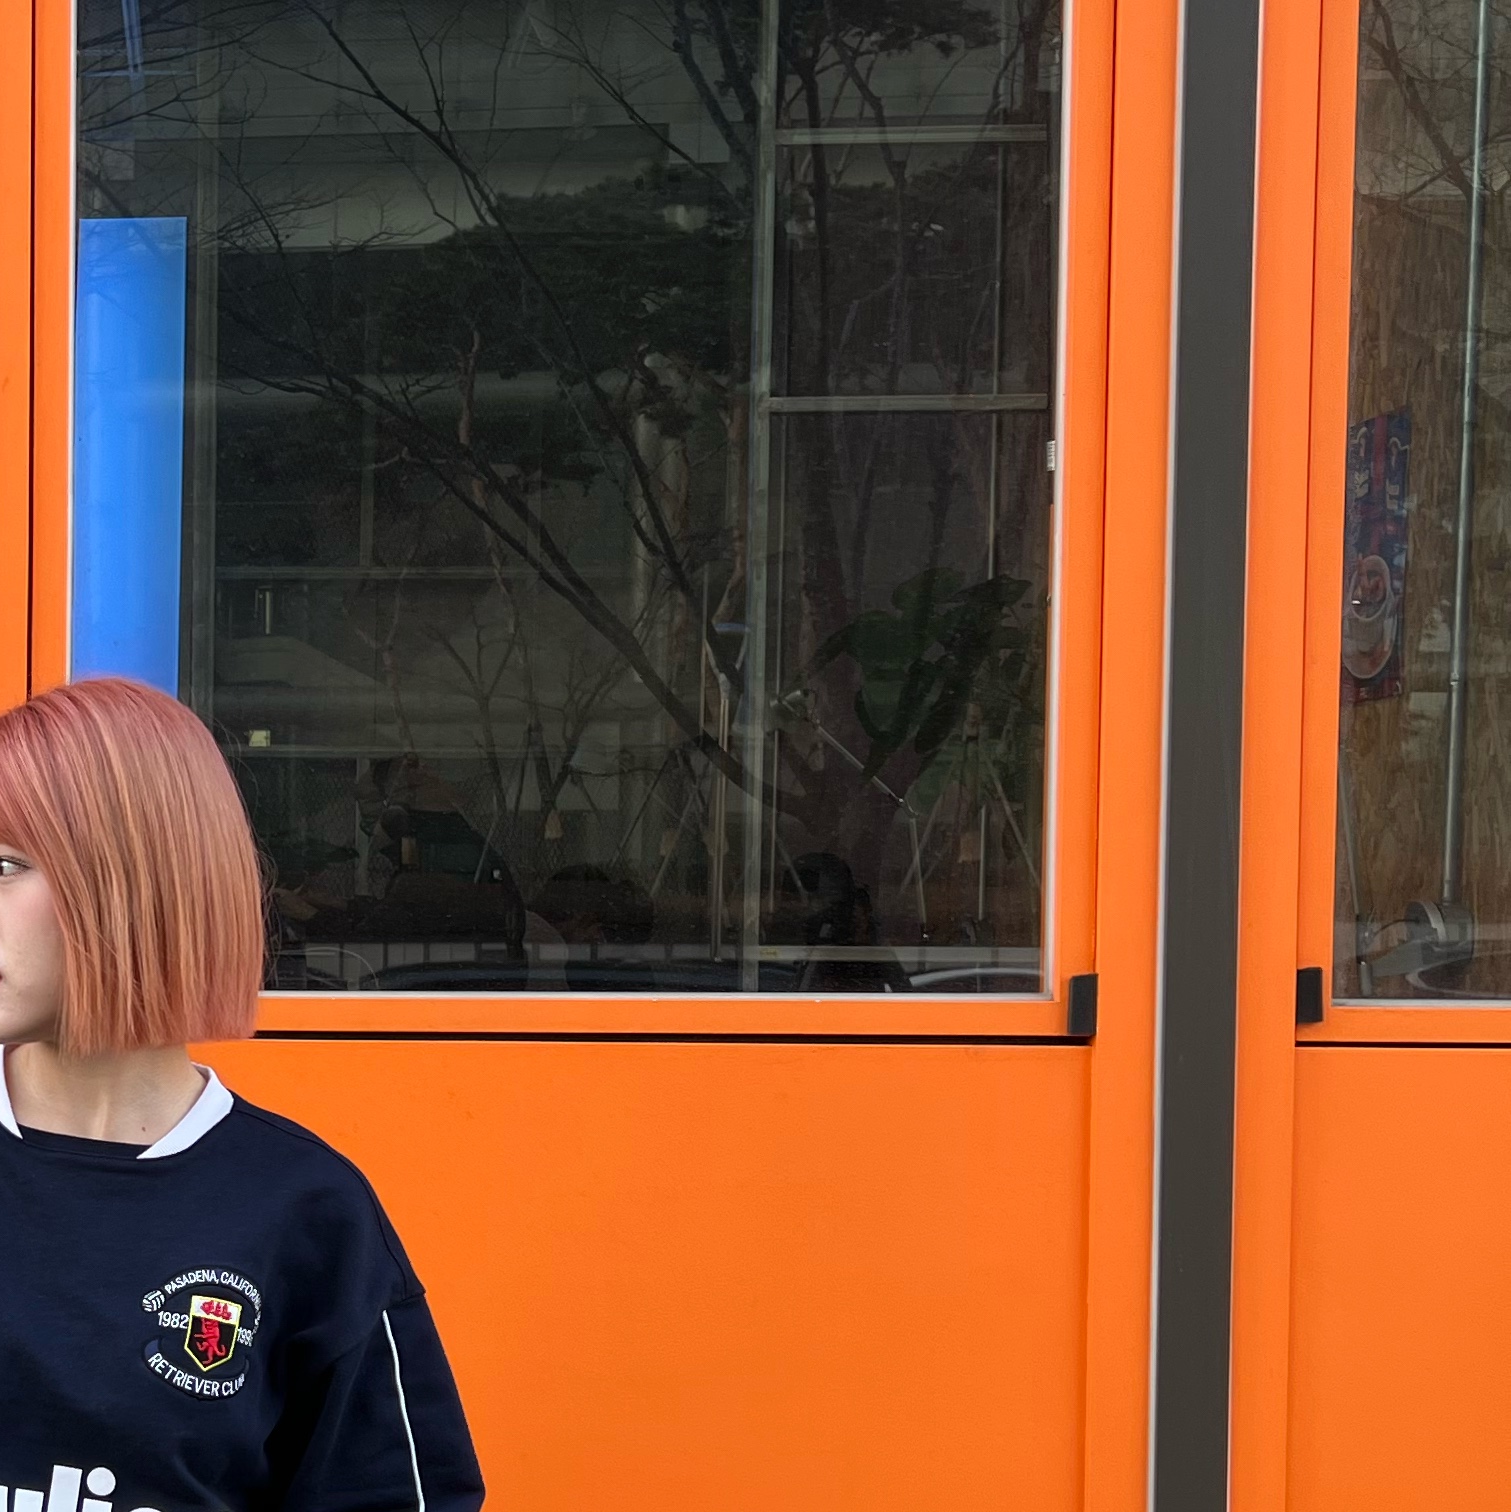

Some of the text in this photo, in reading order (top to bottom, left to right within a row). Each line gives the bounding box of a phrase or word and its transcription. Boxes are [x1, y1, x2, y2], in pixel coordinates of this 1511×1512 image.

[164, 1269, 219, 1295] PASADENA,
[157, 1311, 190, 1329] 1982
[148, 1352, 220, 1397] RETRIEVER
